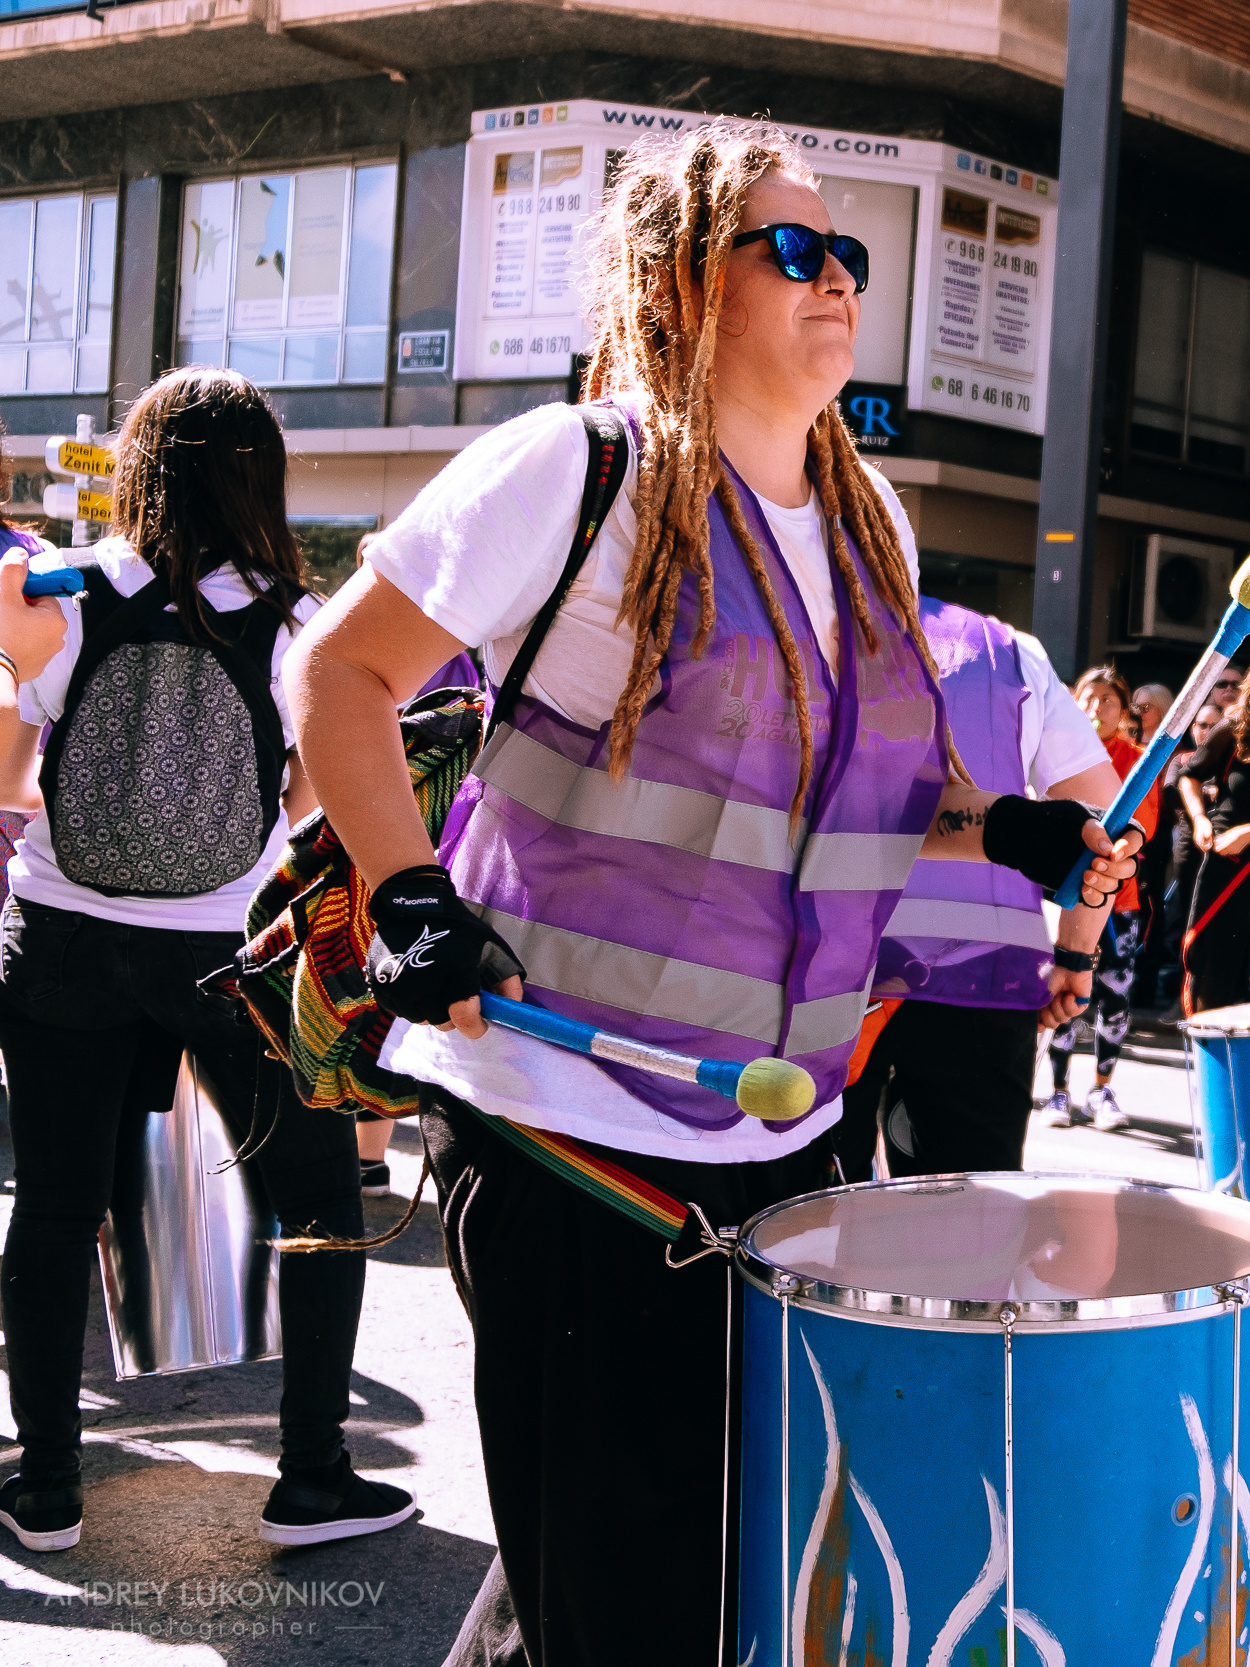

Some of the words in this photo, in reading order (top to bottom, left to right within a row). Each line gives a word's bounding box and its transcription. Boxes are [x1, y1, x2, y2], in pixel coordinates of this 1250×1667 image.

[960, 240, 985, 262] 968
[998, 281, 1028, 294] SERVICIOS
[504, 338, 523, 355] 686
[941, 336, 974, 350] Comercial
[862, 435, 889, 446] RUIZ
[65, 442, 93, 457] hotel
[64, 455, 100, 473] Zenit
[78, 490, 91, 502] tel
